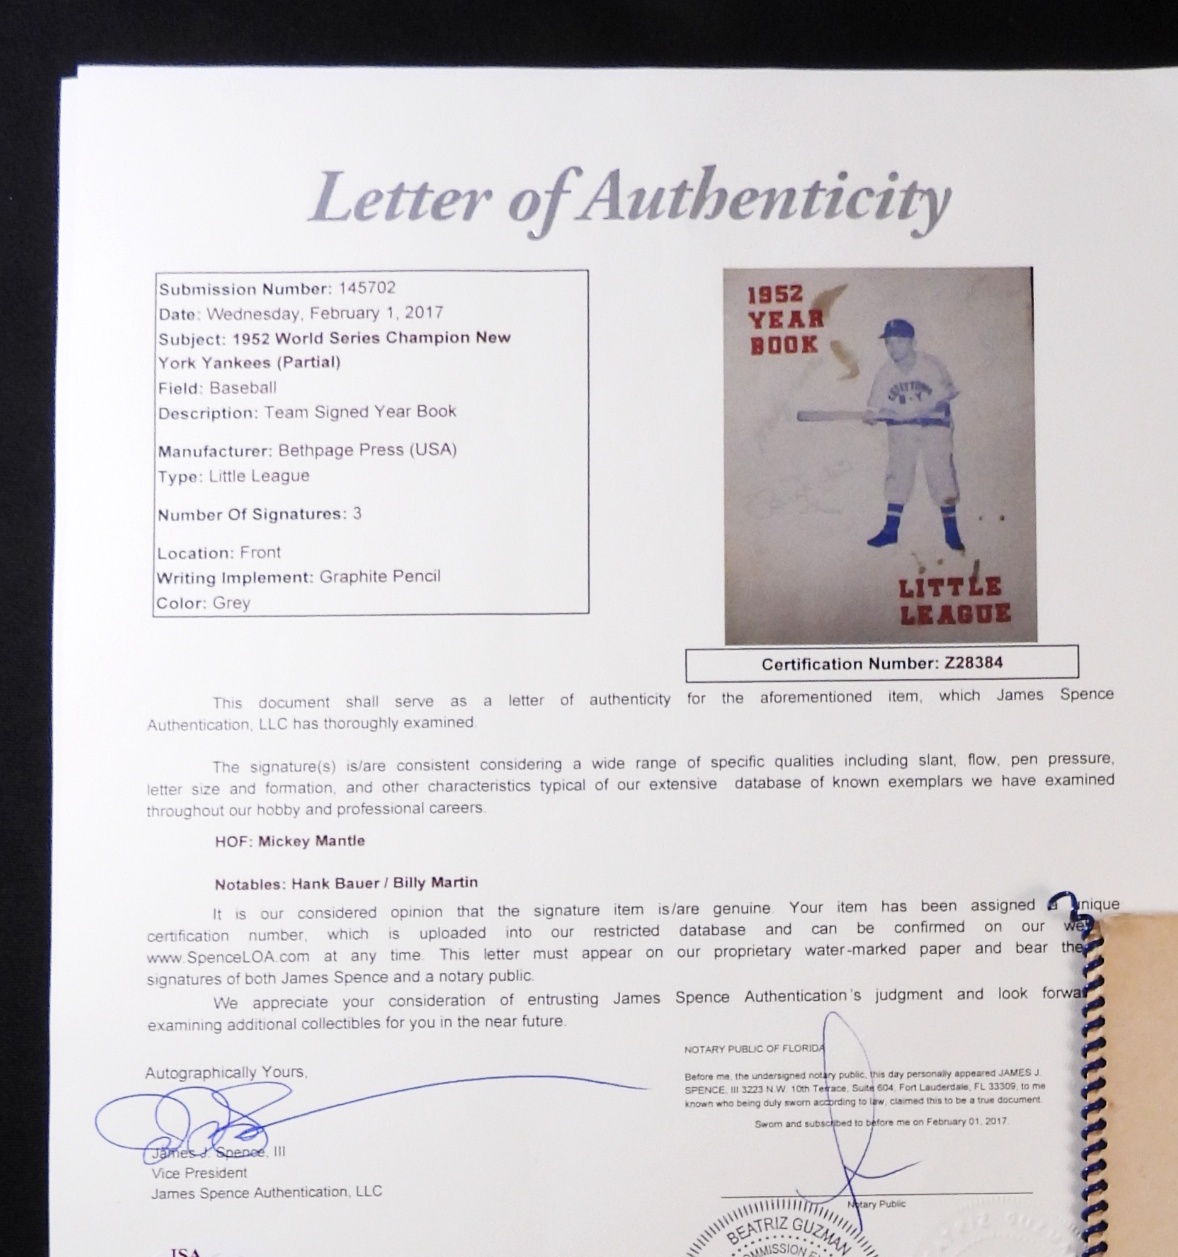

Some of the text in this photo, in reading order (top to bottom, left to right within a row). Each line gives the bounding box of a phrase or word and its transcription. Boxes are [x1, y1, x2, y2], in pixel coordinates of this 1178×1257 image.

[307, 164, 953, 241] Letter of Authenticity
[159, 280, 395, 296] Submission Number: 145702
[747, 284, 804, 305] 1952
[159, 305, 444, 324] Date: Wednesday, February 1, 2017
[747, 309, 826, 330] YEAR
[159, 330, 511, 349] Subject: 1952 World Series Champion New
[750, 334, 819, 356] BOOK
[158, 355, 340, 372] York Yankees (Partial)
[159, 381, 276, 395] Field: Baseball
[159, 404, 456, 422] Description: Team Signed Year Book
[158, 442, 457, 460] Manufacturer: Bethpage Press (USA)
[158, 469, 310, 486] Type: Little League
[158, 506, 362, 524] Number Of Signatures: 3
[158, 545, 281, 560] Location: Front
[156, 569, 440, 589] Writing Implement: Graphite Pencil
[898, 576, 1003, 599] LITTLE
[156, 596, 251, 612] Color: Grey
[900, 602, 1012, 626] LEAGUE
[762, 656, 1003, 671] Certification Number: Z28384
[213, 687, 1114, 709] This document shall serve as a letter of authenticity for the aforementioned item, which James Spence
[216, 834, 365, 850] HOF: Mickey Mantle
[215, 878, 286, 891] Notables:
[292, 878, 330, 890] Hank
[335, 877, 380, 889] Bauer
[393, 876, 426, 891] Billy
[431, 876, 478, 888] Martin
[685, 1043, 825, 1054] NOTARY PUBLIC OF FLORIDA
[145, 1066, 307, 1082] Autographically Yours,
[152, 1167, 247, 1179] Vice President
[151, 1185, 383, 1201] James Spence Authentication, LLC
[727, 1217, 851, 1256] BEATRIZ GUZMAN
